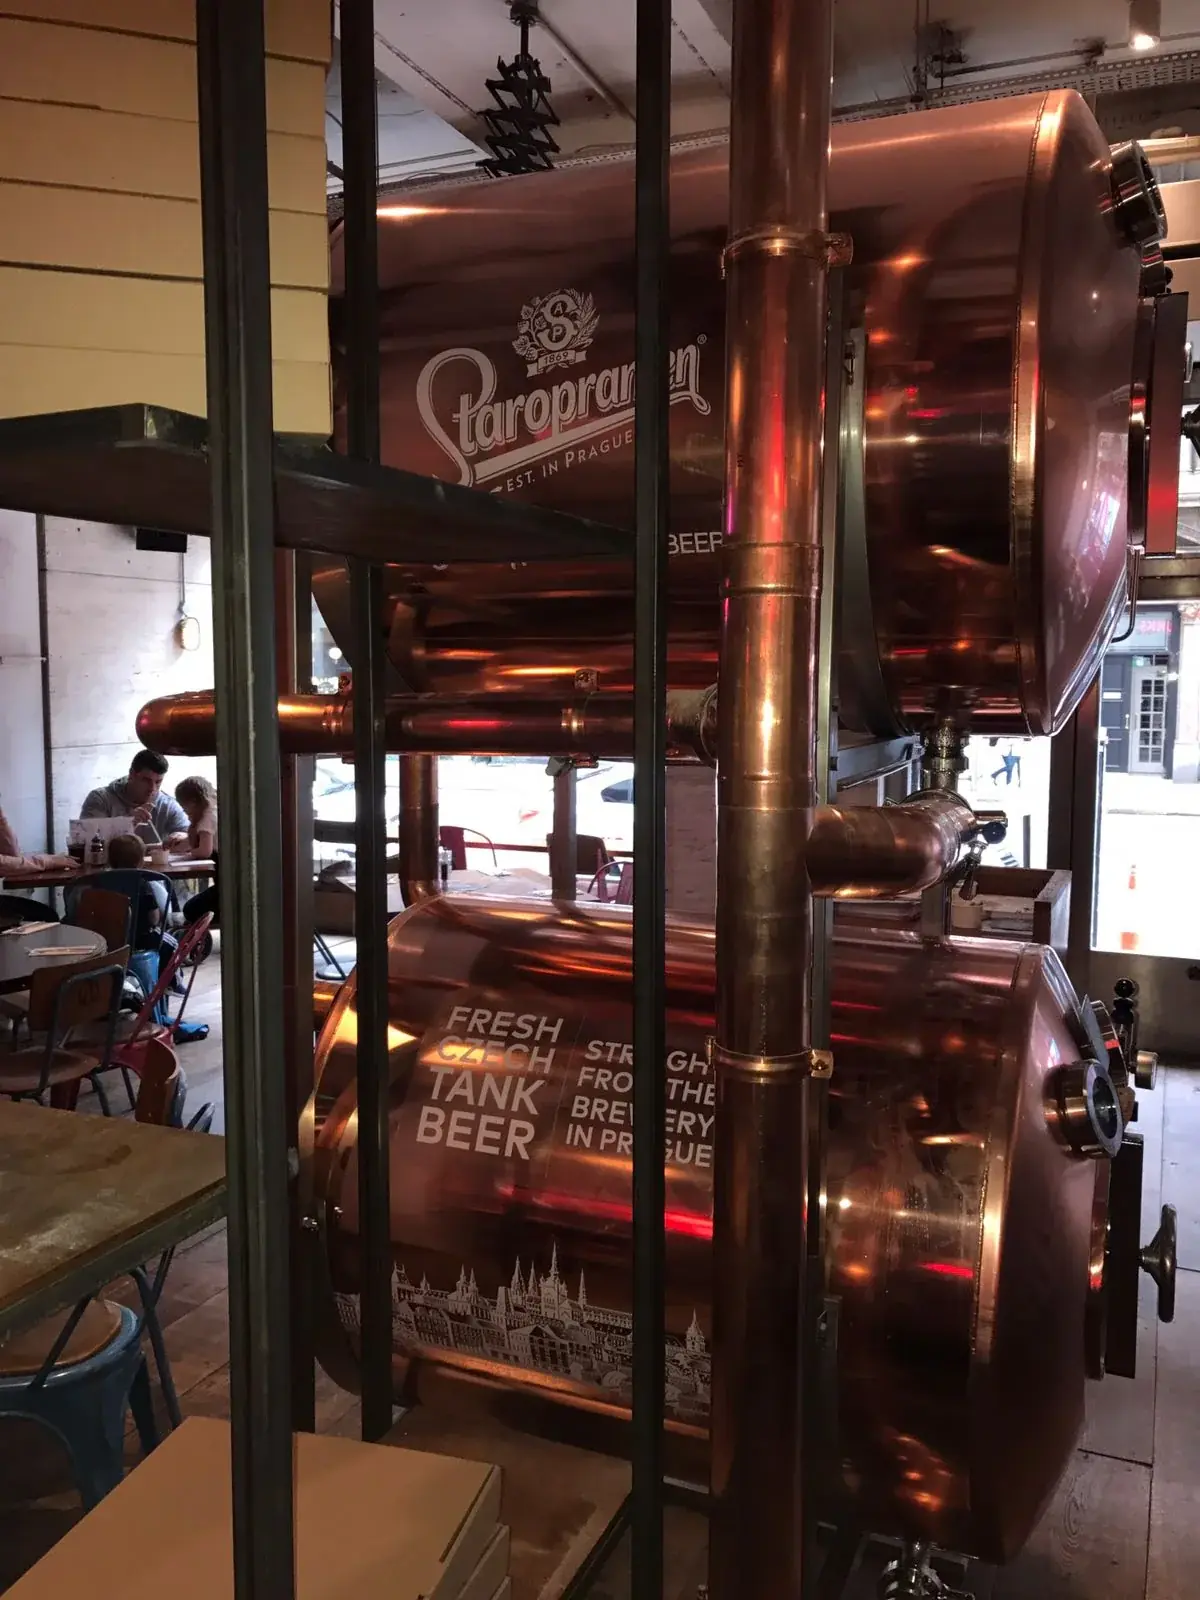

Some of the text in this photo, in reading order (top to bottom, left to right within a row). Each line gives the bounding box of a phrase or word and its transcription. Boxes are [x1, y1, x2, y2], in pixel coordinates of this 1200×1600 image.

[544, 351, 569, 364] 1869
[506, 429, 633, 492] EST. IN PRAGUE
[446, 1006, 564, 1043] FRESH
[439, 1035, 556, 1074] CZECH
[584, 1040, 709, 1075] STRGH
[430, 1064, 546, 1116] TANK
[577, 1066, 716, 1106] FRO THE
[416, 1105, 536, 1160] BEER
[571, 1095, 715, 1138] BREERY
[565, 1123, 713, 1168] IN PRUE
